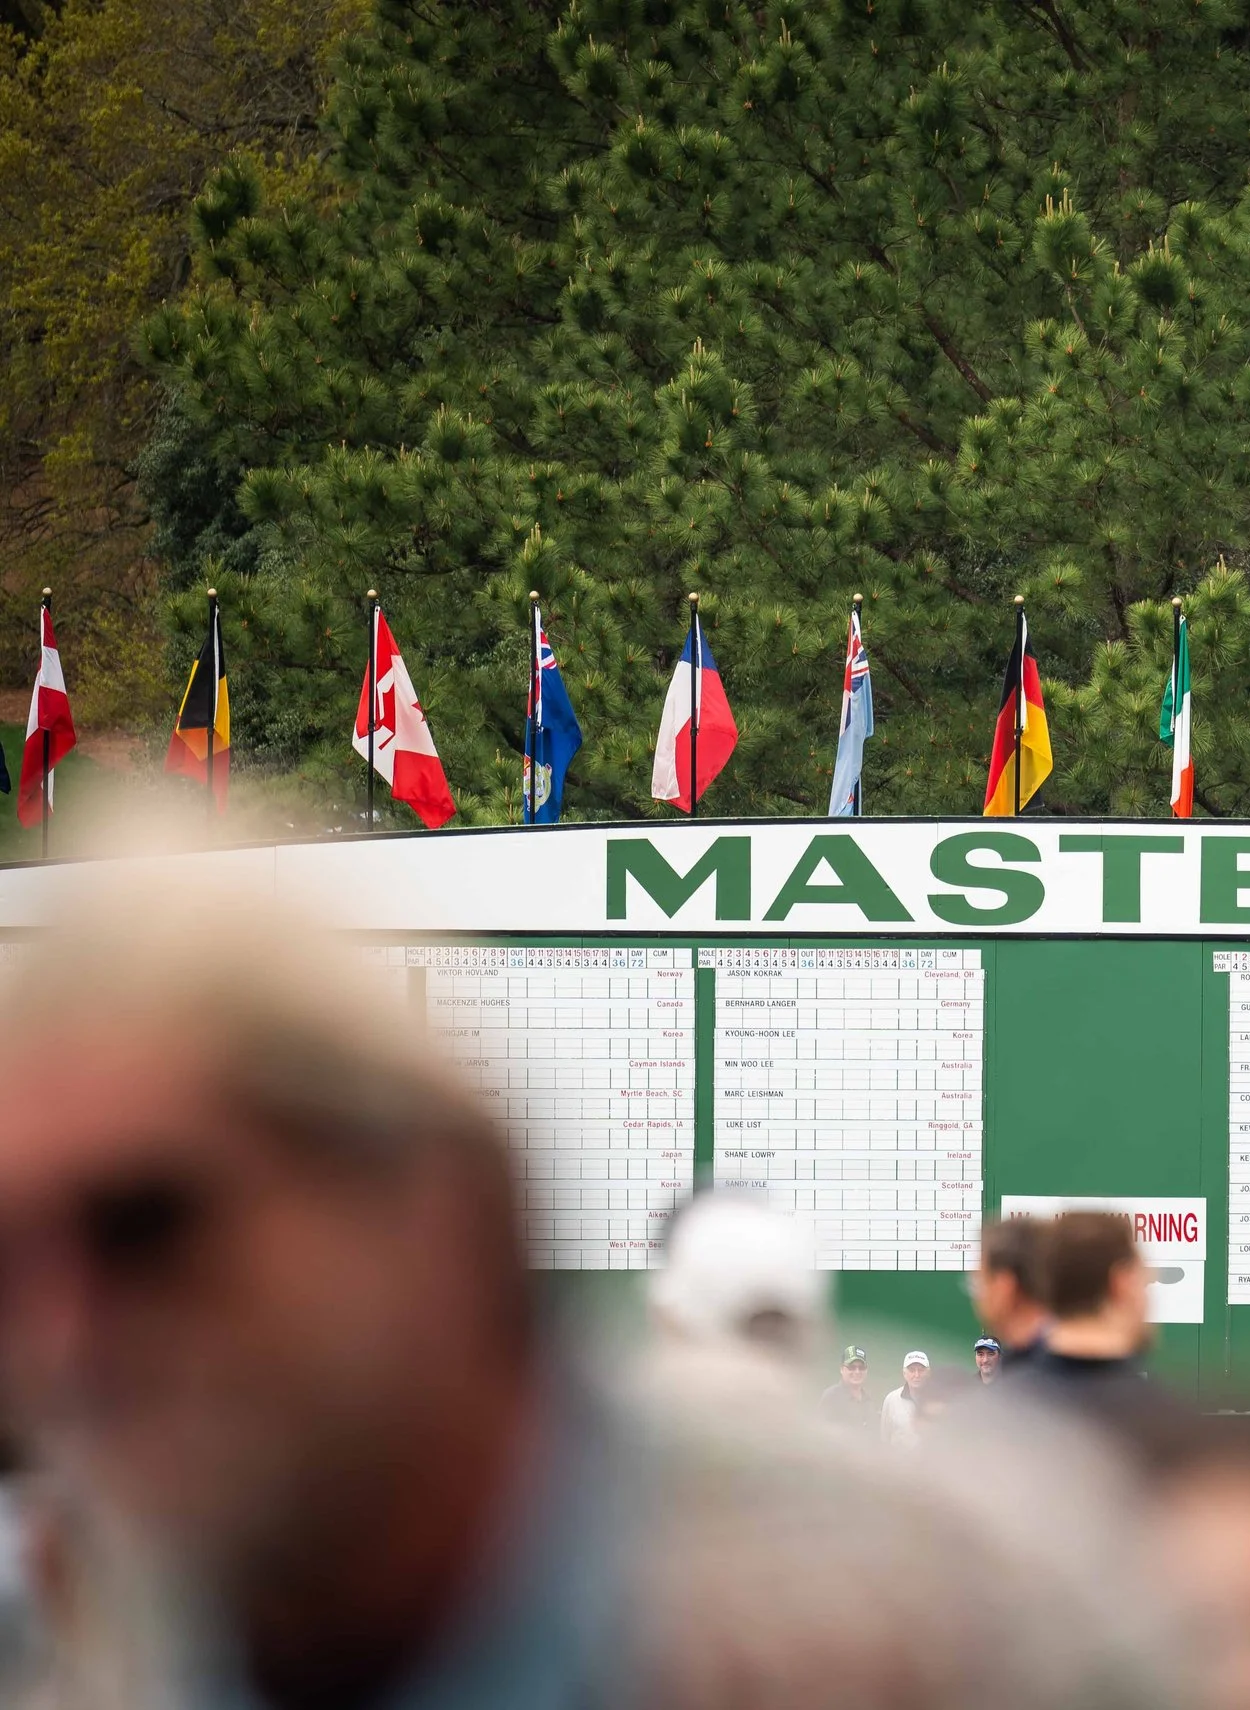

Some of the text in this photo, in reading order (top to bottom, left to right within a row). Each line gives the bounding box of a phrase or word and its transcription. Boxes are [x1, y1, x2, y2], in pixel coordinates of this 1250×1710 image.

[437, 969, 498, 977] VIKTOR HOVLAND
[658, 970, 683, 979] Norway
[727, 969, 782, 978] JASON KOKRAK
[437, 999, 510, 1007] MACKENZIE HUGHES
[657, 1000, 683, 1008] Canada
[726, 999, 796, 1008] BERNHARD LANGER
[941, 1000, 970, 1009] Germany
[663, 1030, 683, 1038] Korea
[725, 1030, 795, 1038] KYOUNG-HOON LEE
[953, 1031, 973, 1040] Korea
[629, 1060, 685, 1069] Cayman Islands
[725, 1060, 773, 1068] MIN WOO LEE
[941, 1061, 972, 1070] Australia
[621, 1089, 642, 1099] Myrtle
[673, 1089, 682, 1098] SC
[725, 1090, 783, 1098] MARC LEISHMAN
[726, 1120, 761, 1129] LUKE LIST
[661, 1150, 682, 1160] Japan
[725, 1150, 775, 1159] SHANE LOWRY
[947, 1151, 971, 1160] Ireland
[942, 1181, 973, 1190] Scotland
[950, 1242, 971, 1251] Japan
